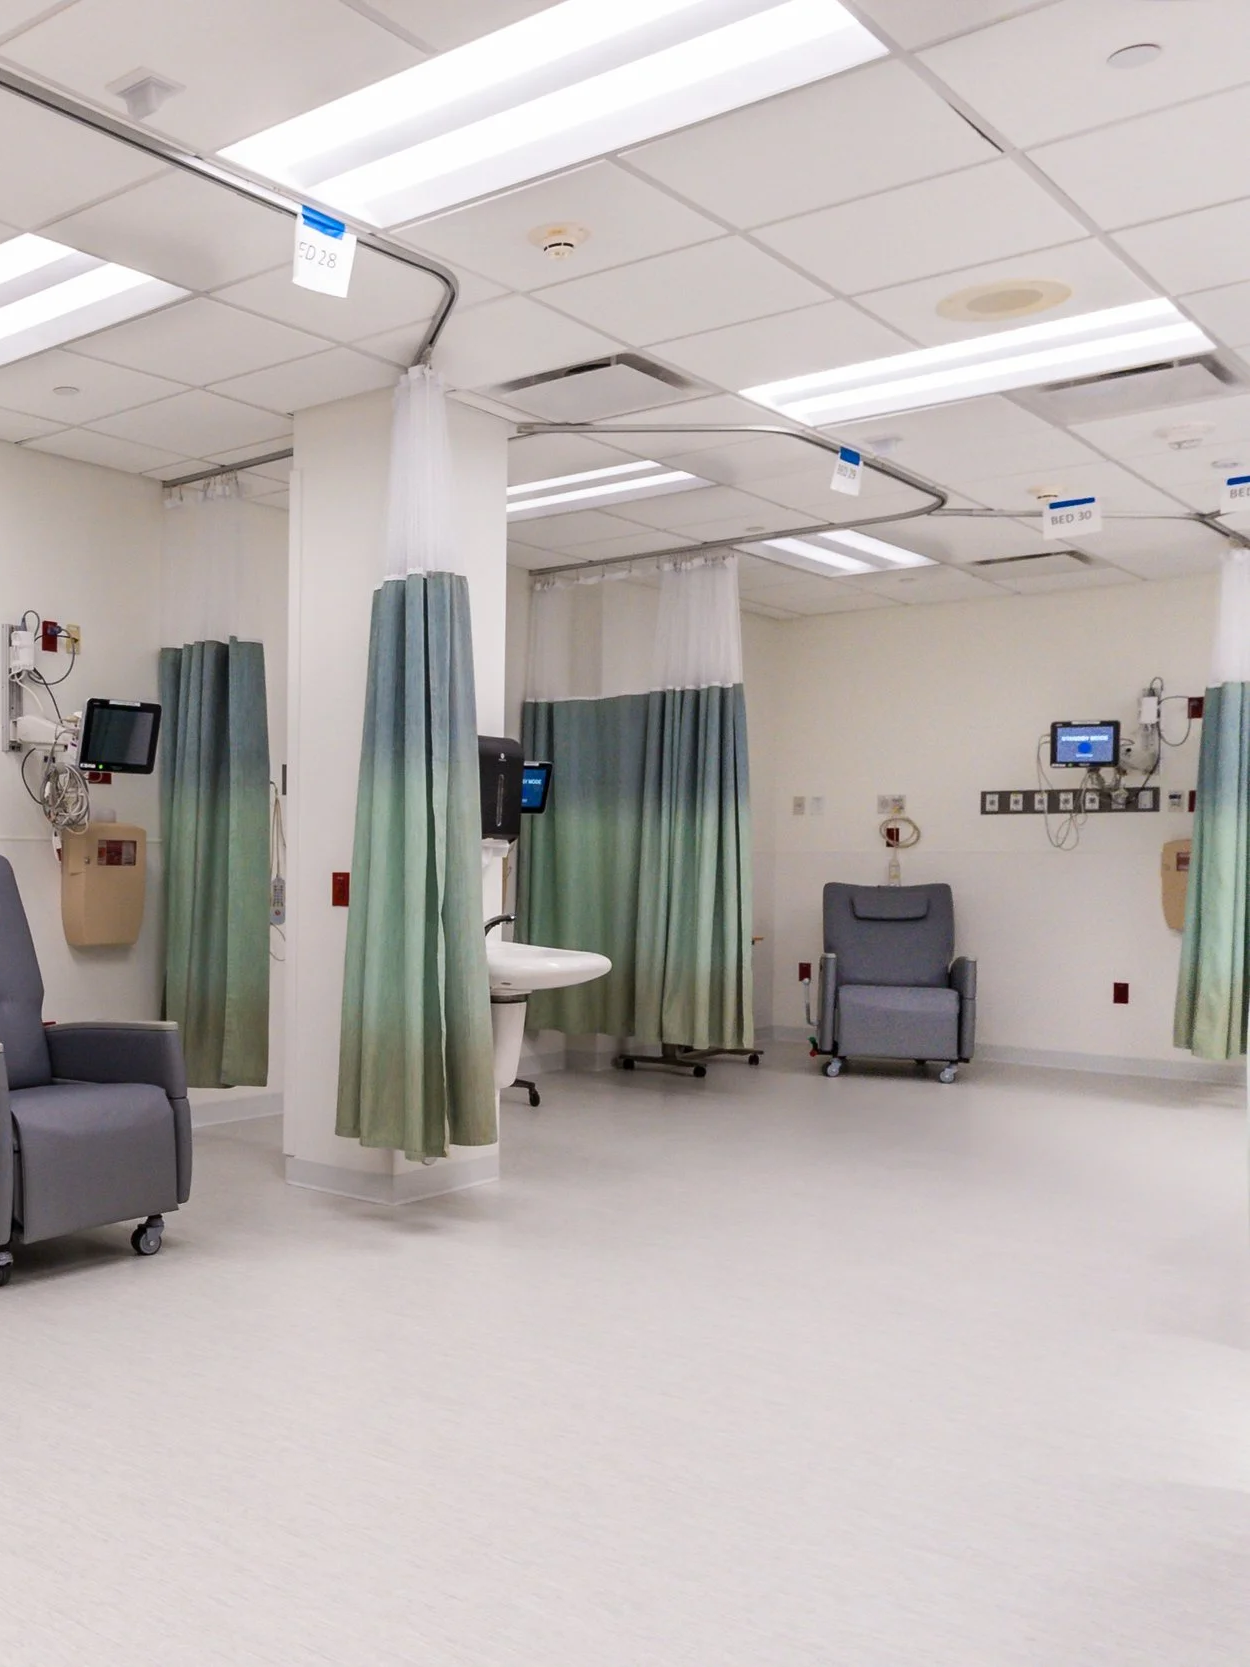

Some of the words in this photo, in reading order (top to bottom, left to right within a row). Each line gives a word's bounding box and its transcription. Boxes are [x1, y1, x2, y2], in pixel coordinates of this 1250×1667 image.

[299, 241, 316, 261] ED
[318, 249, 337, 269] 28
[1050, 513, 1075, 526] BED
[1077, 510, 1093, 522] 30
